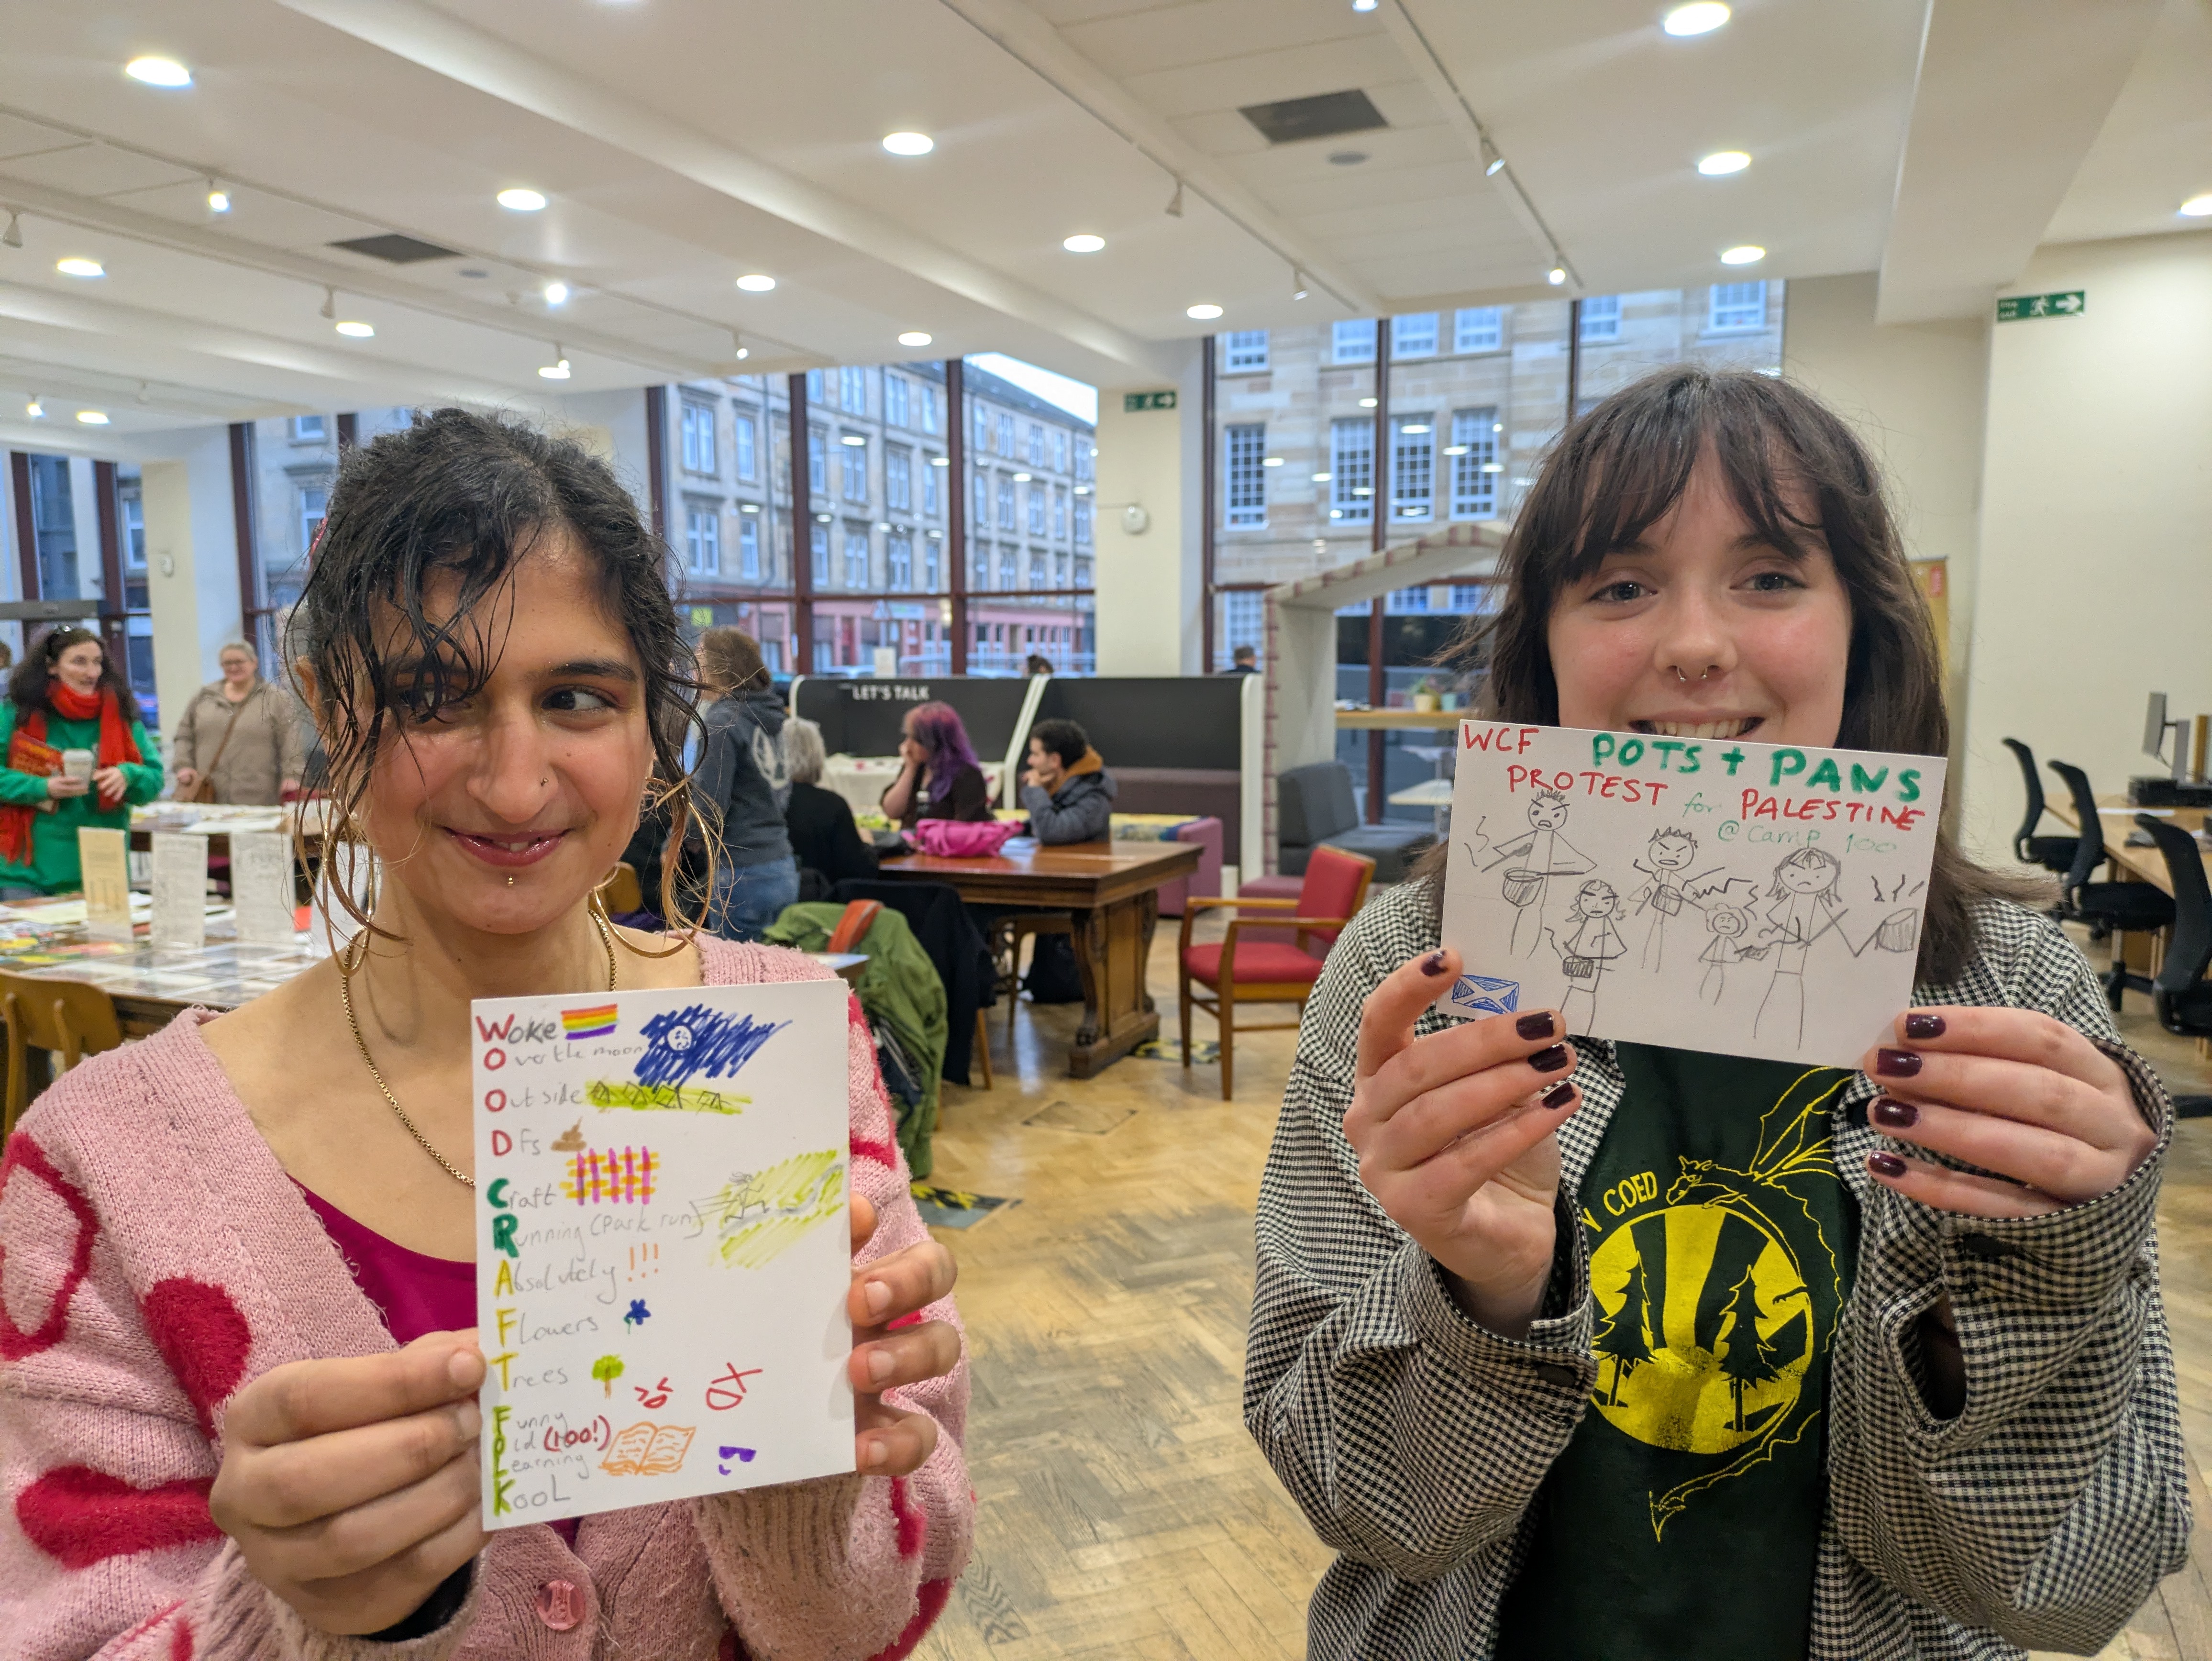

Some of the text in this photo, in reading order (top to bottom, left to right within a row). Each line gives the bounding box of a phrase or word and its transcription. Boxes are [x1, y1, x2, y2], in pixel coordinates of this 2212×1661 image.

[852, 684, 929, 700] LET'S TALK
[1464, 724, 1539, 754] WCF
[1592, 732, 1702, 774] POTS
[1770, 748, 1921, 802] PANS
[1507, 764, 1925, 831] PROTEST for PALESTINE
[1846, 833, 1898, 853] 100
[476, 1013, 557, 1044] Woke
[593, 1045, 644, 1057] moon
[487, 1177, 557, 1209] Craft
[1604, 1171, 1658, 1217] COED
[493, 1213, 586, 1262] Running
[496, 1307, 599, 1348] Flowers
[489, 1351, 568, 1392] Trees
[492, 1405, 572, 1448] Funny
